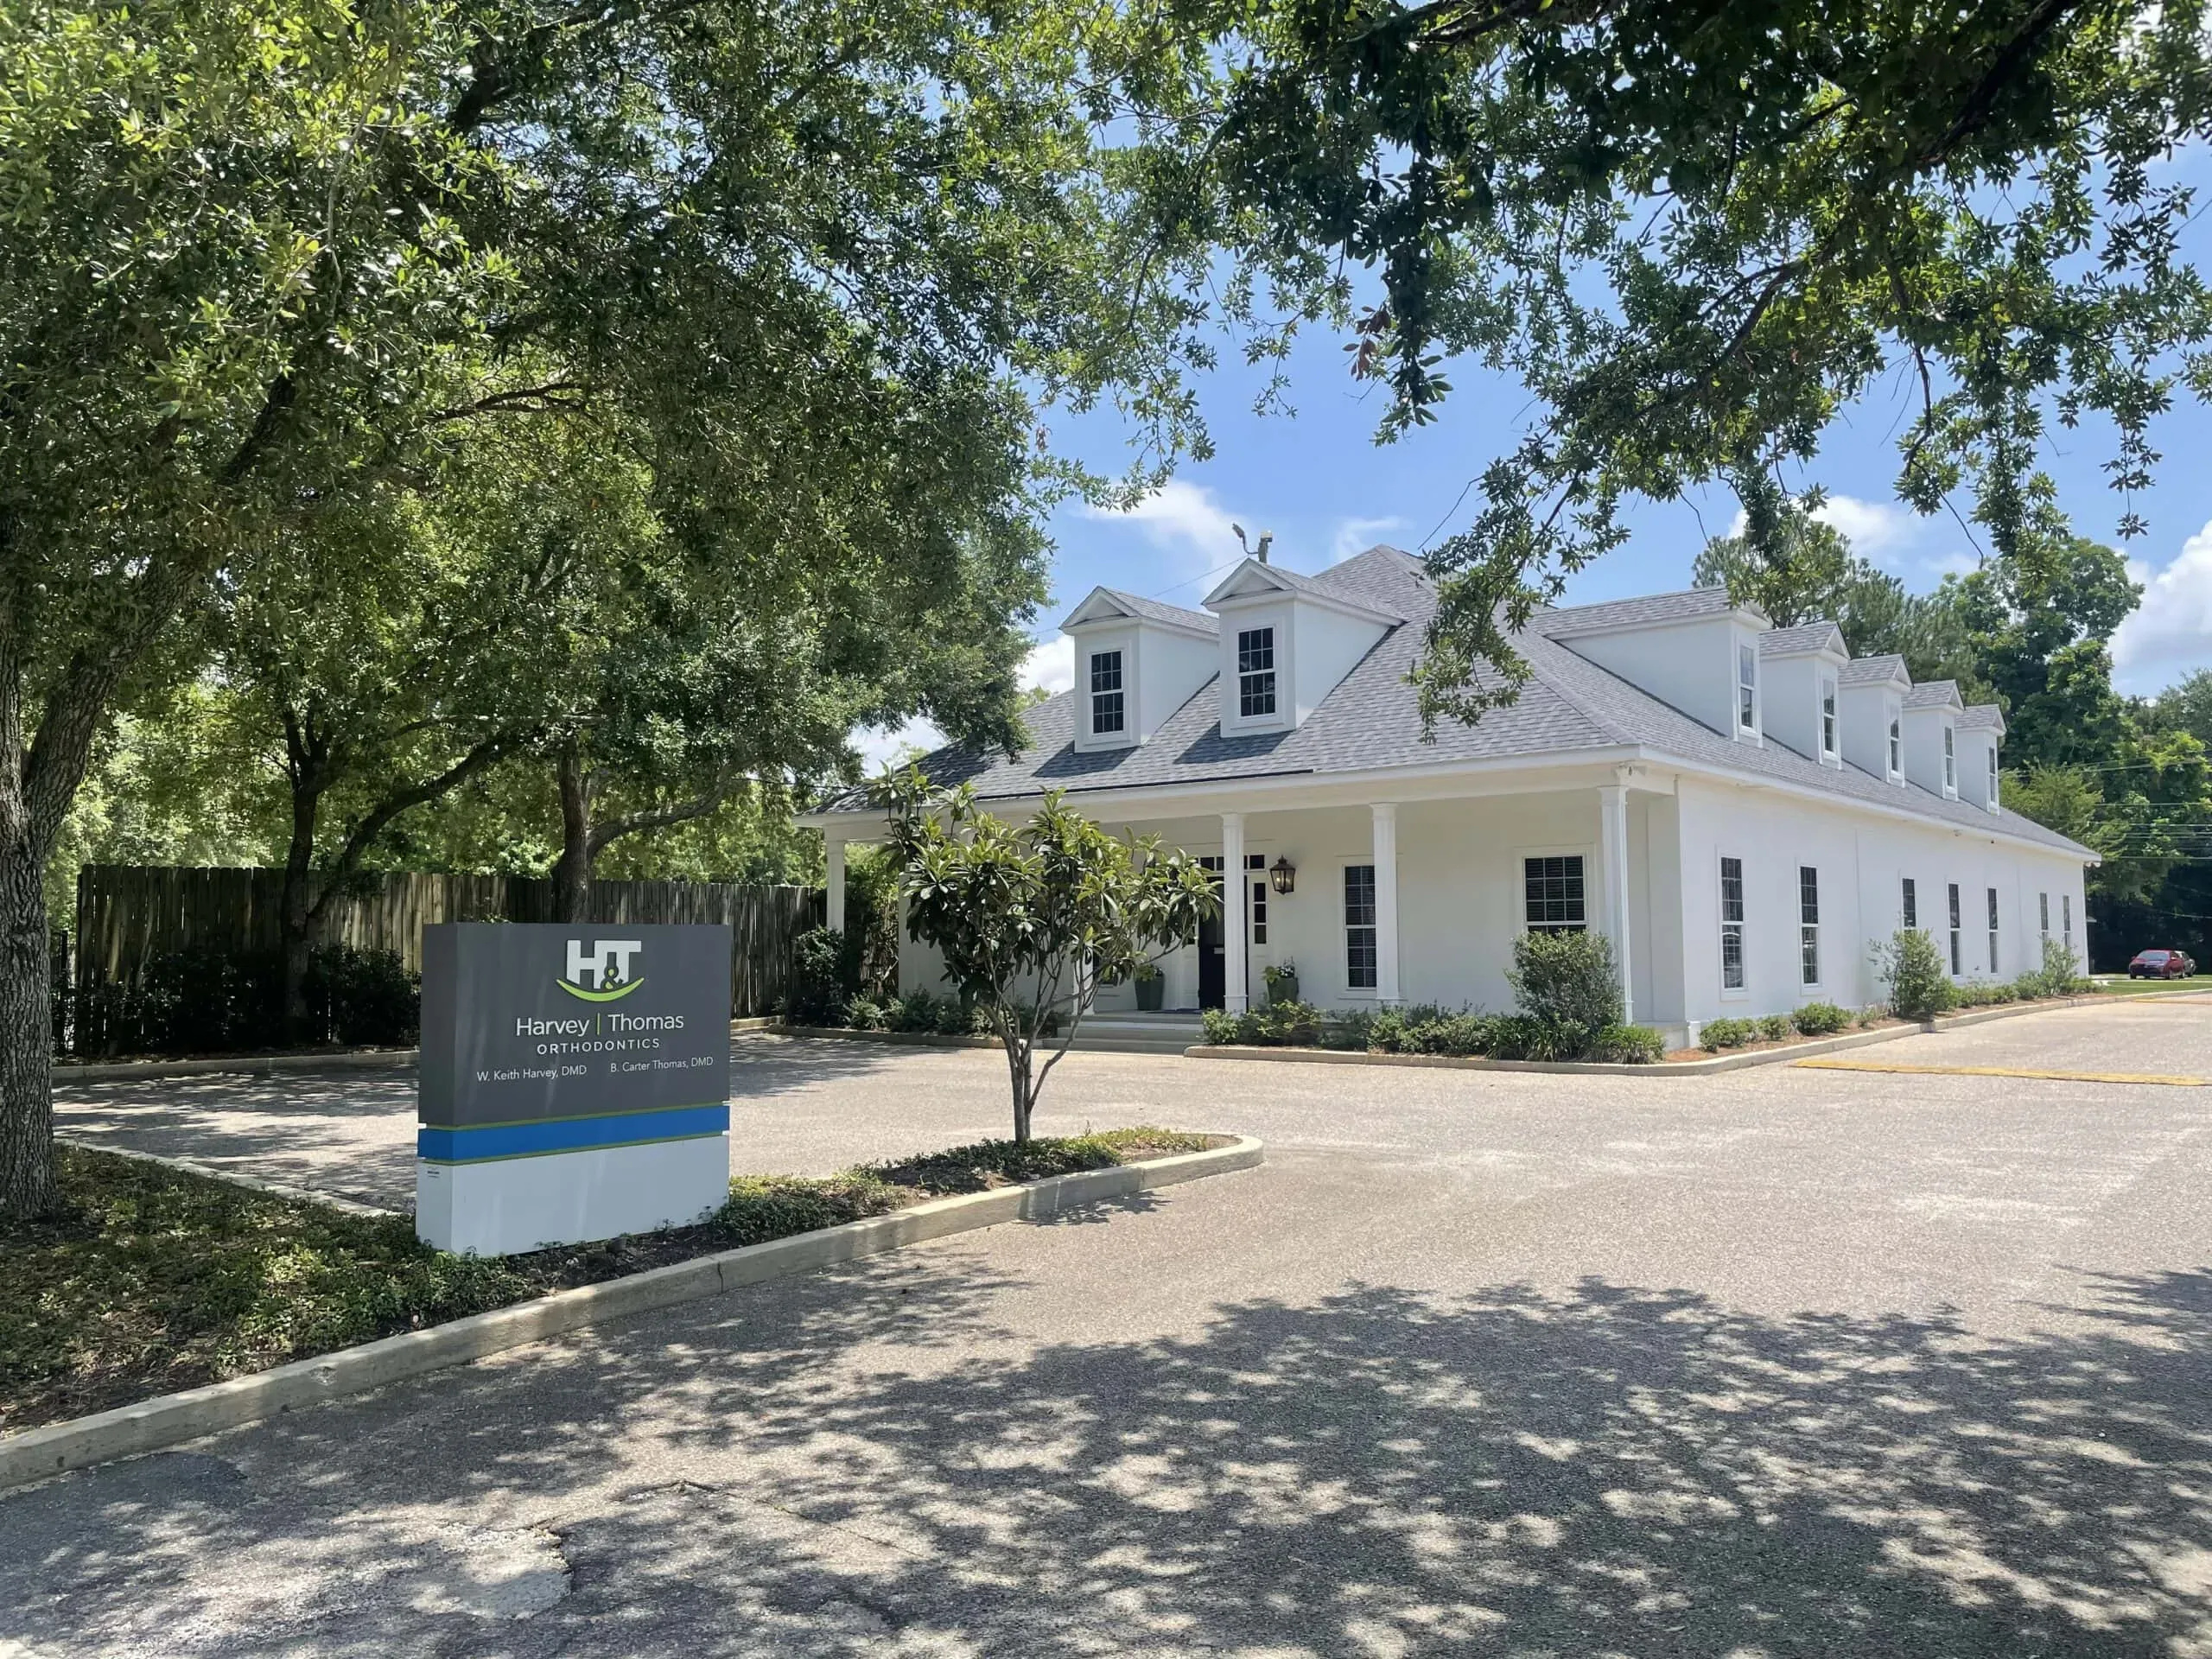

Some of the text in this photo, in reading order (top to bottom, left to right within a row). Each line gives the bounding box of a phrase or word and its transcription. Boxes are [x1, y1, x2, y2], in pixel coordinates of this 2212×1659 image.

[516, 1013, 684, 1038] Harvey Thomas
[537, 1038, 660, 1055] ORTHODONTICS
[610, 1056, 714, 1072] B. Carter Thomas, DMD
[476, 1065, 588, 1082] W. Keith Harvey, DMD
